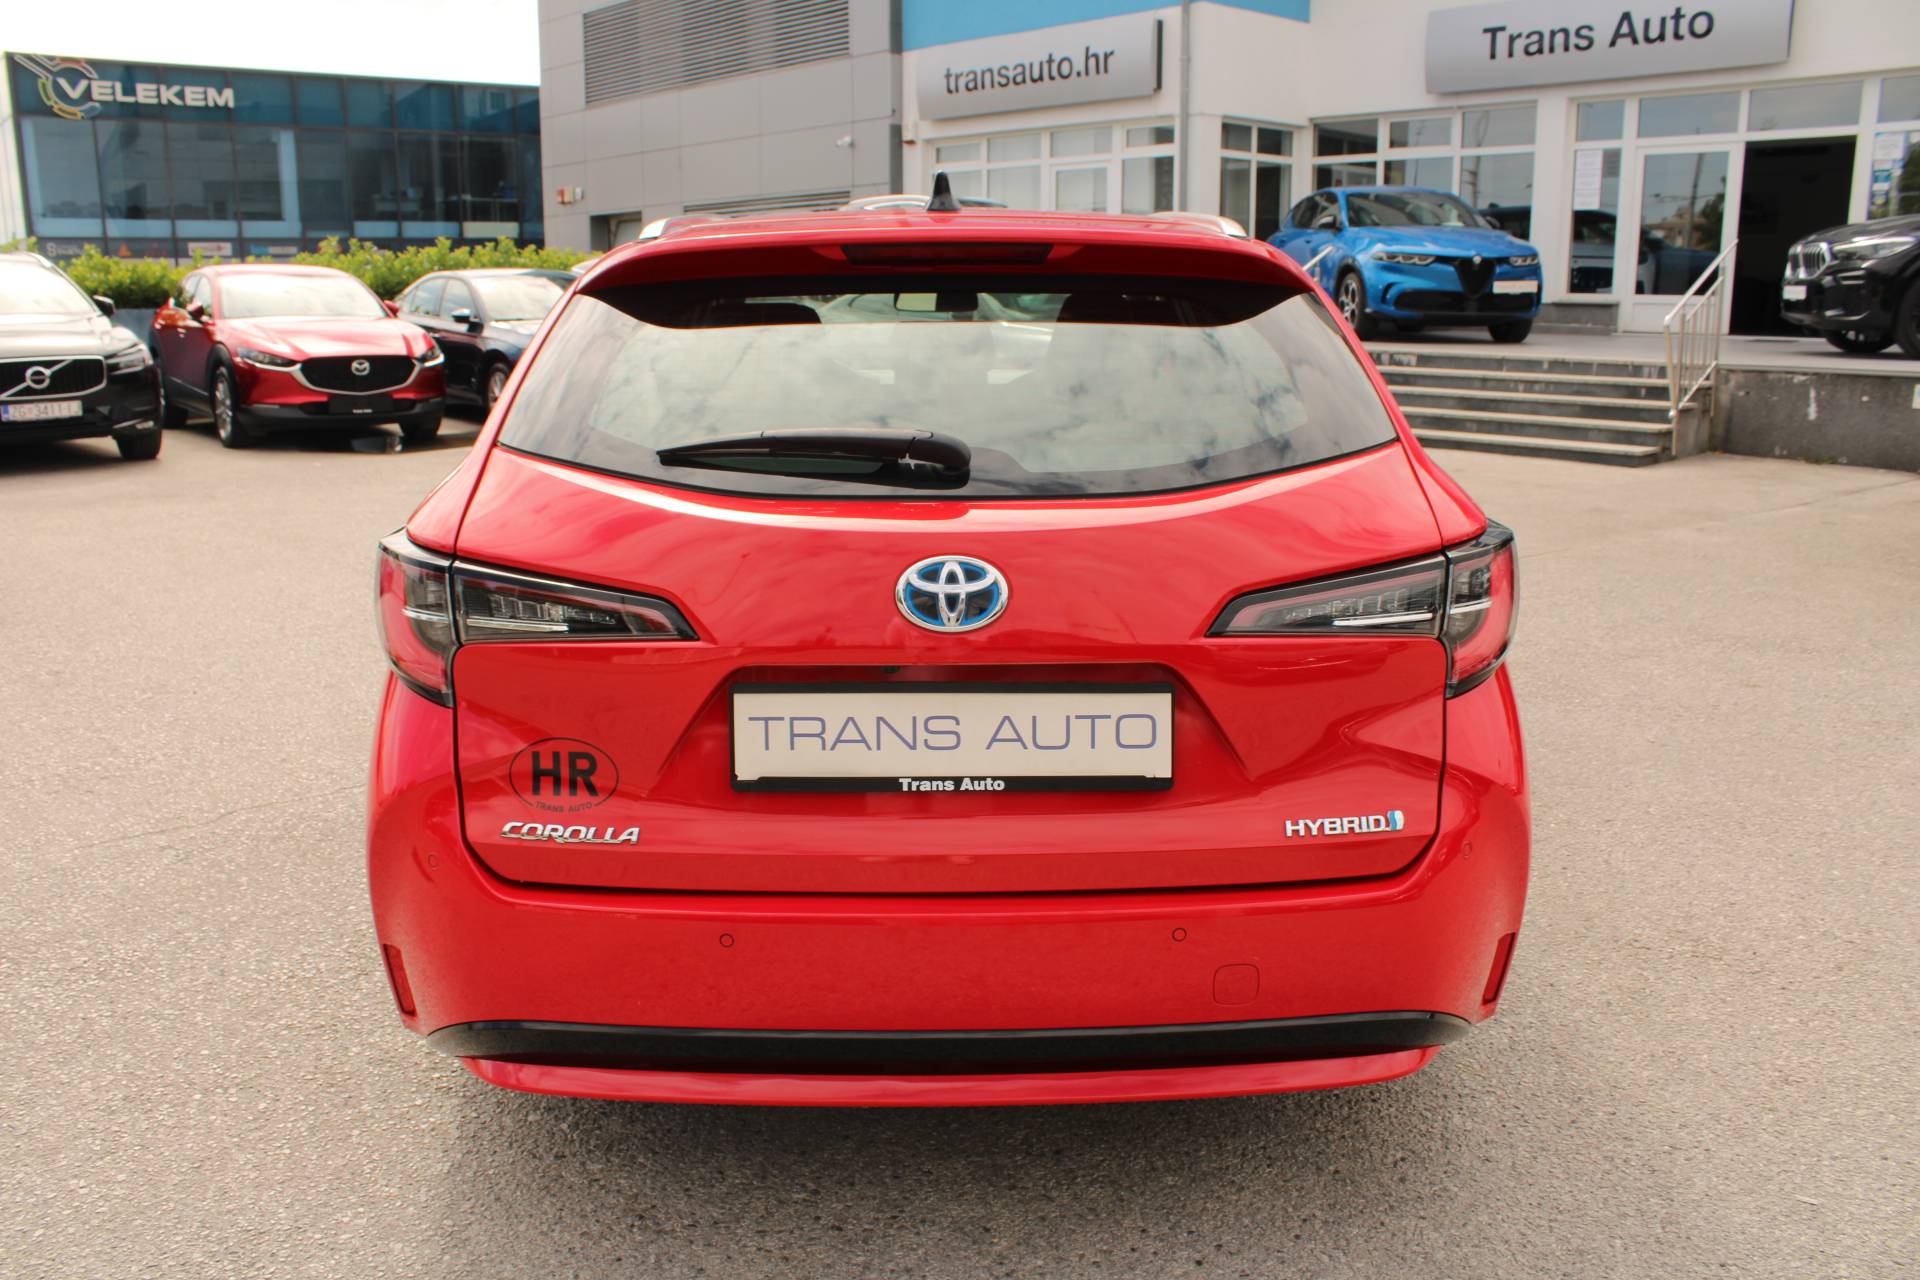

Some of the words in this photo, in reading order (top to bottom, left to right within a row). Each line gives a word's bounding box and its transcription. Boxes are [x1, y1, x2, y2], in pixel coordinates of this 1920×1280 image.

[1482, 24, 1595, 60] Trans
[1608, 6, 1715, 48] Auto
[944, 45, 1115, 95] transauto.hr
[55, 76, 235, 109] VELEKEM
[748, 715, 961, 751] TRANS
[985, 713, 1157, 750] AUTO
[531, 751, 599, 797] HR
[899, 777, 955, 792] Trans
[959, 777, 1006, 791] Auto
[535, 801, 564, 813] TRANS
[568, 801, 594, 813] AUTO
[500, 821, 641, 845] COROLLA
[1285, 814, 1387, 837] HYBRID
